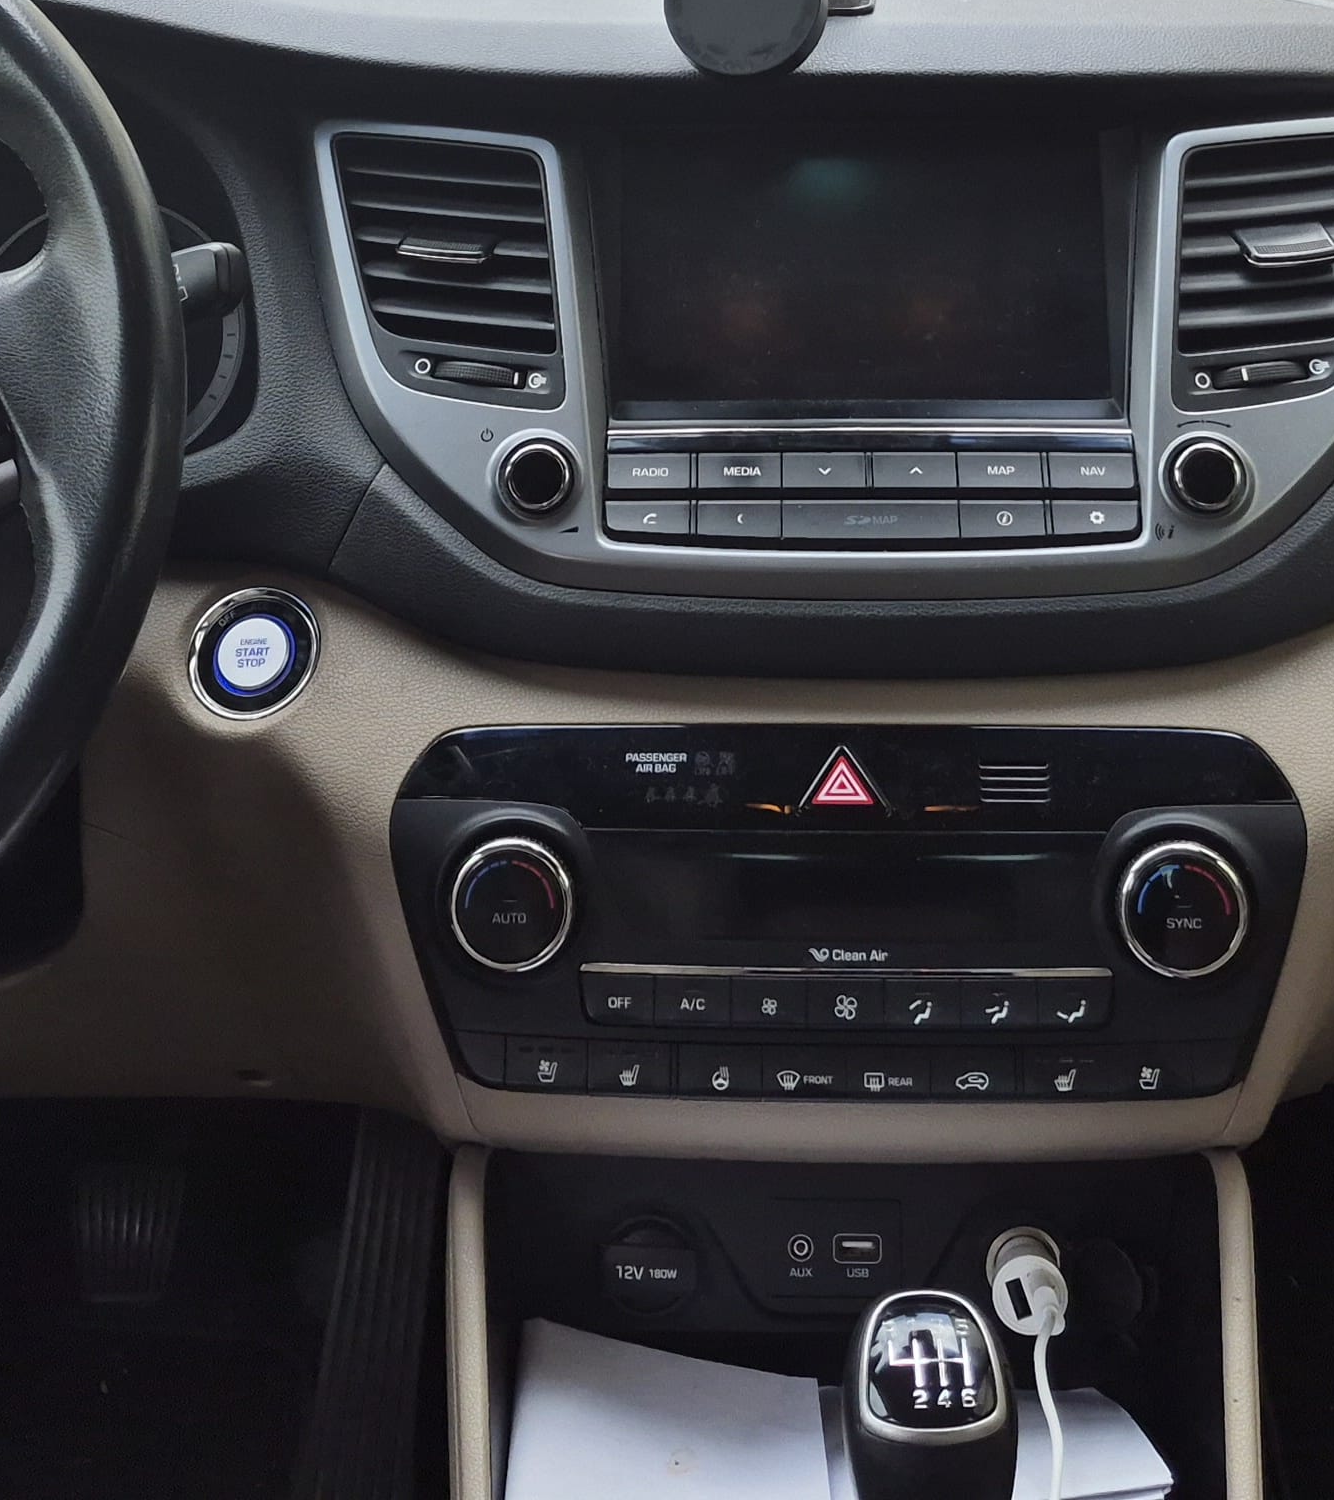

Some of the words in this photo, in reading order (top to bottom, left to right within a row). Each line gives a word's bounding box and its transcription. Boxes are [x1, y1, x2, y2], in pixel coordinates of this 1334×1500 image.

[632, 467, 669, 478] RADIO
[723, 466, 761, 477] MEDIA
[987, 465, 1015, 476] MAP
[1080, 466, 1106, 476] NAV
[872, 515, 898, 525] MAP
[218, 610, 236, 628] OFF
[235, 647, 270, 657] START
[237, 658, 265, 668] STOP
[625, 753, 687, 763] PASSENGER
[635, 763, 653, 773] AIR
[654, 763, 677, 773] BAG
[492, 912, 527, 924] AUTO
[1166, 917, 1202, 930] SYNC
[832, 949, 867, 962] Clean
[869, 949, 888, 961] Air
[607, 996, 632, 1009] OFF
[680, 998, 706, 1011] A/C
[803, 1075, 834, 1085] FRONT
[887, 1076, 913, 1086] REAR
[616, 1265, 644, 1280] 12V
[649, 1268, 677, 1279] 180W
[789, 1268, 812, 1278] AUX
[846, 1268, 869, 1278] USB
[912, 1389, 929, 1409] 2
[937, 1389, 952, 1408] 4
[960, 1388, 977, 1408] 6
